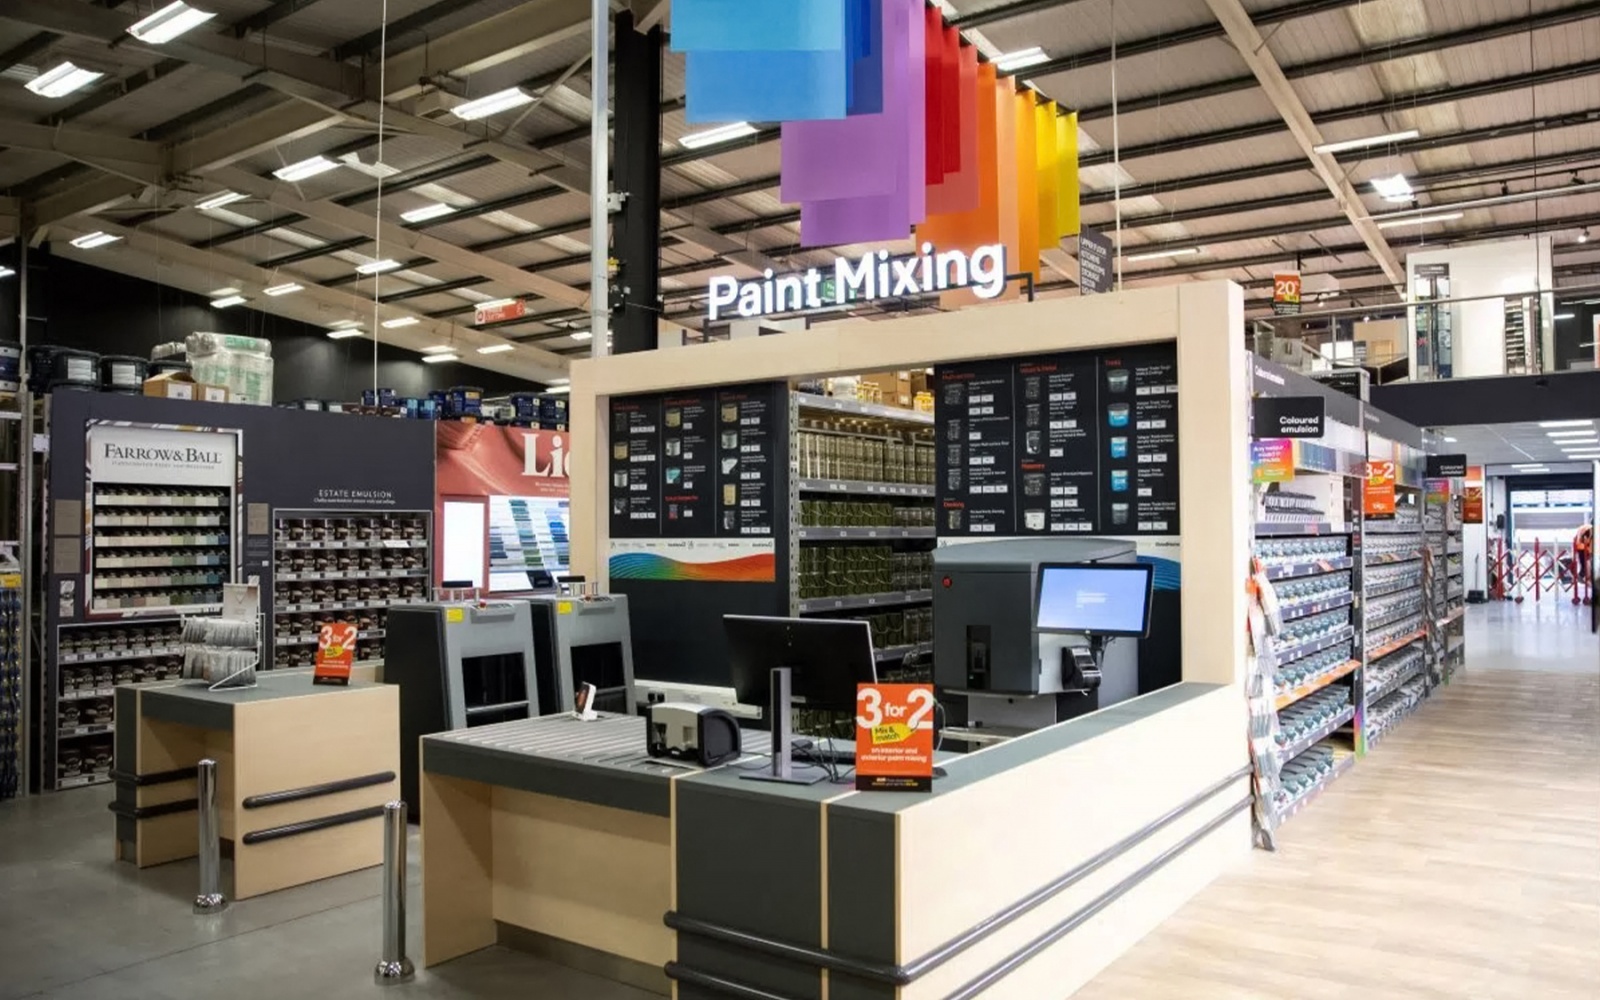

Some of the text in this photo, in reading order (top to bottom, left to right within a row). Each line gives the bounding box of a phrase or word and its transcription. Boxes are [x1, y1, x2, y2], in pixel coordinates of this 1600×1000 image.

[708, 242, 1007, 321] Paint Mixing
[1279, 416, 1319, 424] Coloured
[521, 433, 570, 477] Li
[1383, 462, 1395, 479] 2
[318, 489, 392, 499] ESTATE EMULSION
[319, 625, 333, 649] 3
[342, 626, 358, 650] 2
[856, 687, 934, 729] 3 for 2
